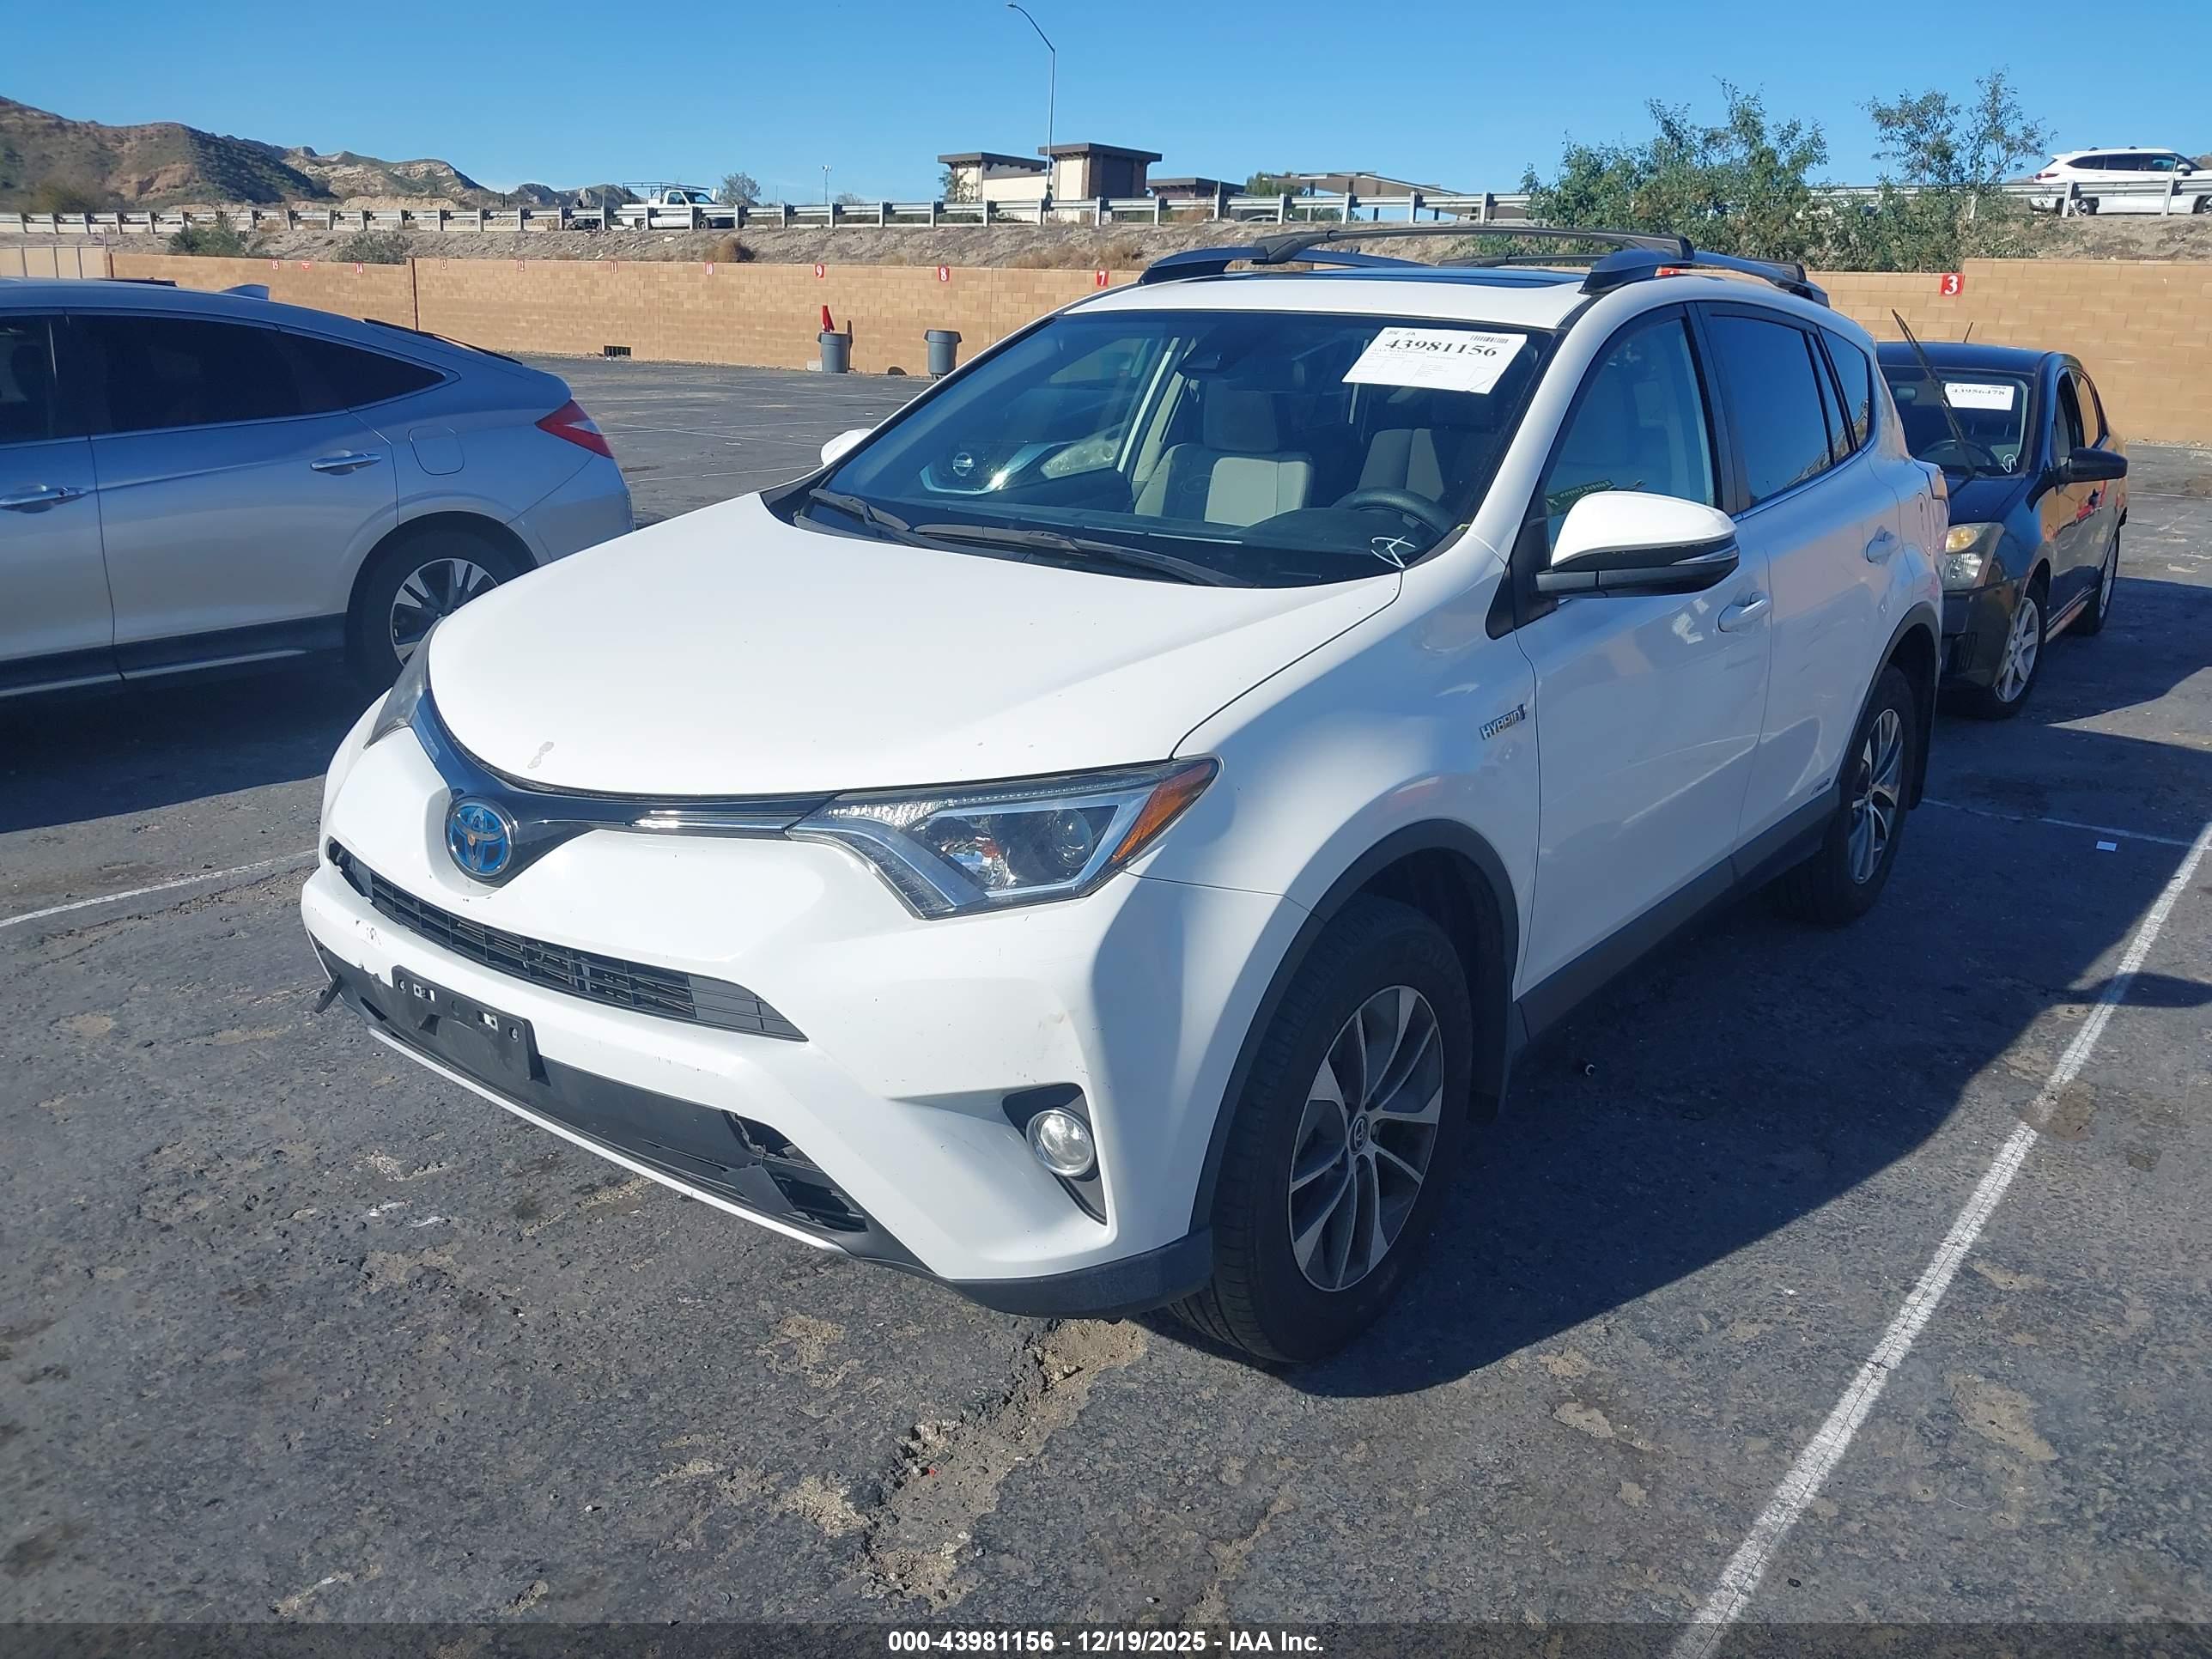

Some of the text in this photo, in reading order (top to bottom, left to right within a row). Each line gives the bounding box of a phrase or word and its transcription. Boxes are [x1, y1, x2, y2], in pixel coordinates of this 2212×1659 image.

[271, 260, 279, 270] 15
[356, 264, 364, 274] 14
[440, 259, 447, 270] 13
[518, 261, 525, 271] 12
[611, 261, 618, 273] 11
[706, 263, 714, 275] 10
[816, 265, 823, 278] 9
[940, 267, 948, 281] 8
[1098, 270, 1107, 286] 7
[1943, 275, 1960, 295] 3
[1384, 338, 1500, 357] 43981156
[1480, 709, 1522, 740] HYBRID
